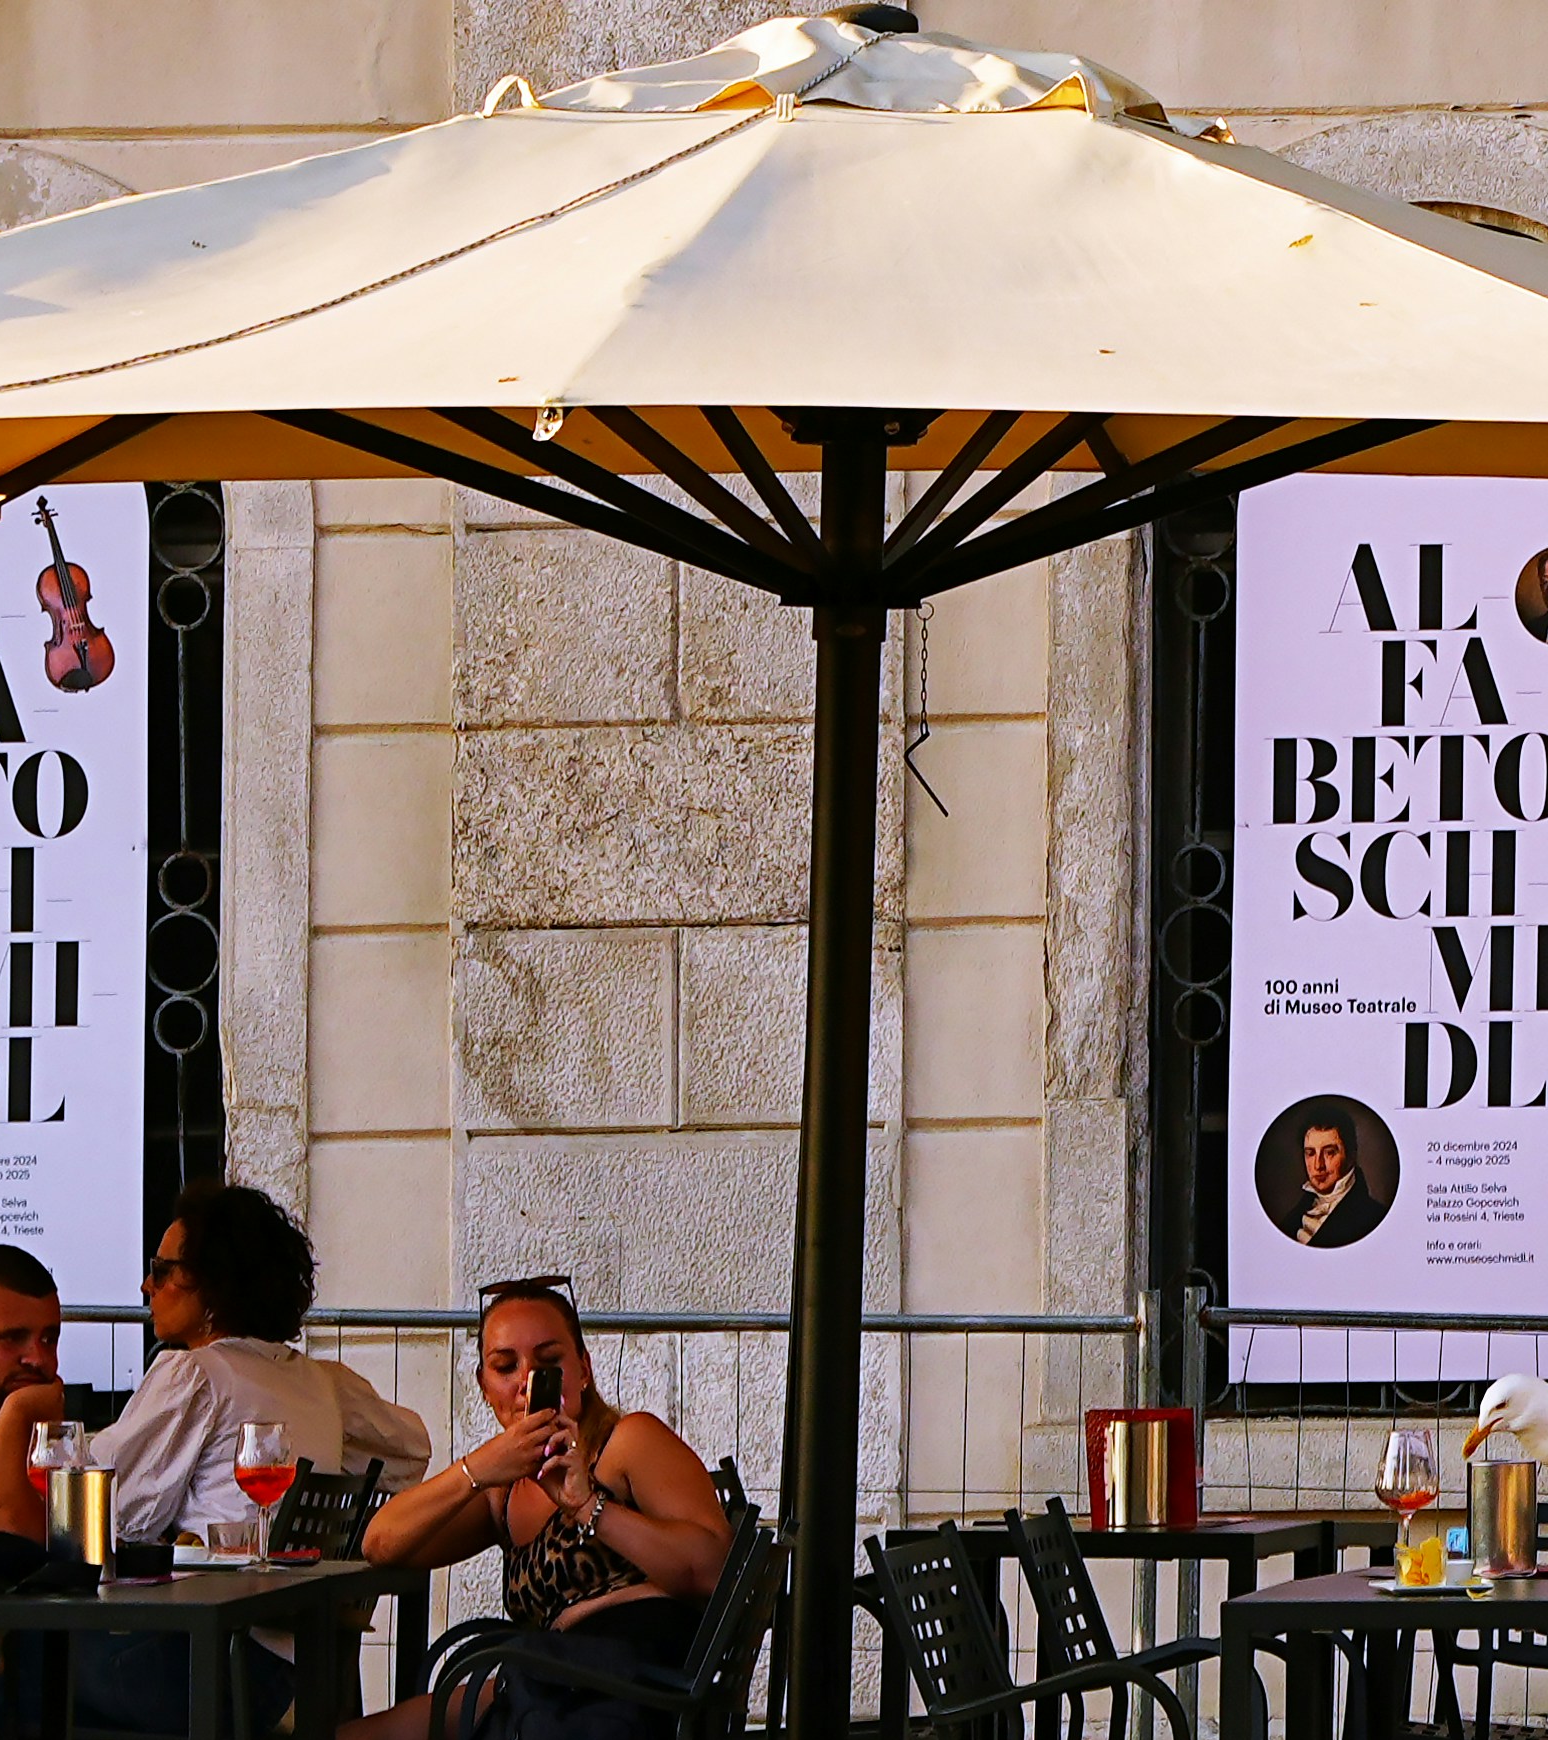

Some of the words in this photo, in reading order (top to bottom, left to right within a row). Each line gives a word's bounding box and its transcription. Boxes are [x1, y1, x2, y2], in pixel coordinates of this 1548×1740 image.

[1264, 979, 1298, 996] 100
[1301, 977, 1339, 995] anni
[1264, 998, 1281, 1016] di
[1284, 999, 1343, 1016] Museo
[1346, 996, 1417, 1015] Teatrale
[1394, 1019, 1547, 1111] DL
[1427, 1141, 1441, 1152] 20
[1443, 1140, 1490, 1152] dicembre
[1492, 1140, 1518, 1151] 2024
[12, 1155, 38, 1166] 2024
[1435, 1155, 1443, 1165] 4
[1445, 1155, 1483, 1168] maggio
[1485, 1154, 1511, 1165] 2025
[5, 1169, 30, 1180] 2025
[1427, 1183, 1448, 1194] Sala
[1481, 1182, 1507, 1194] Selva
[1, 1197, 28, 1208] Selva
[1426, 1197, 1464, 1209] Palazzo
[1426, 1212, 1441, 1223] via
[1443, 1211, 1478, 1222] Rossini
[1493, 1211, 1525, 1222] Trieste
[12, 1225, 44, 1236] Trieste
[1426, 1240, 1446, 1250] Info
